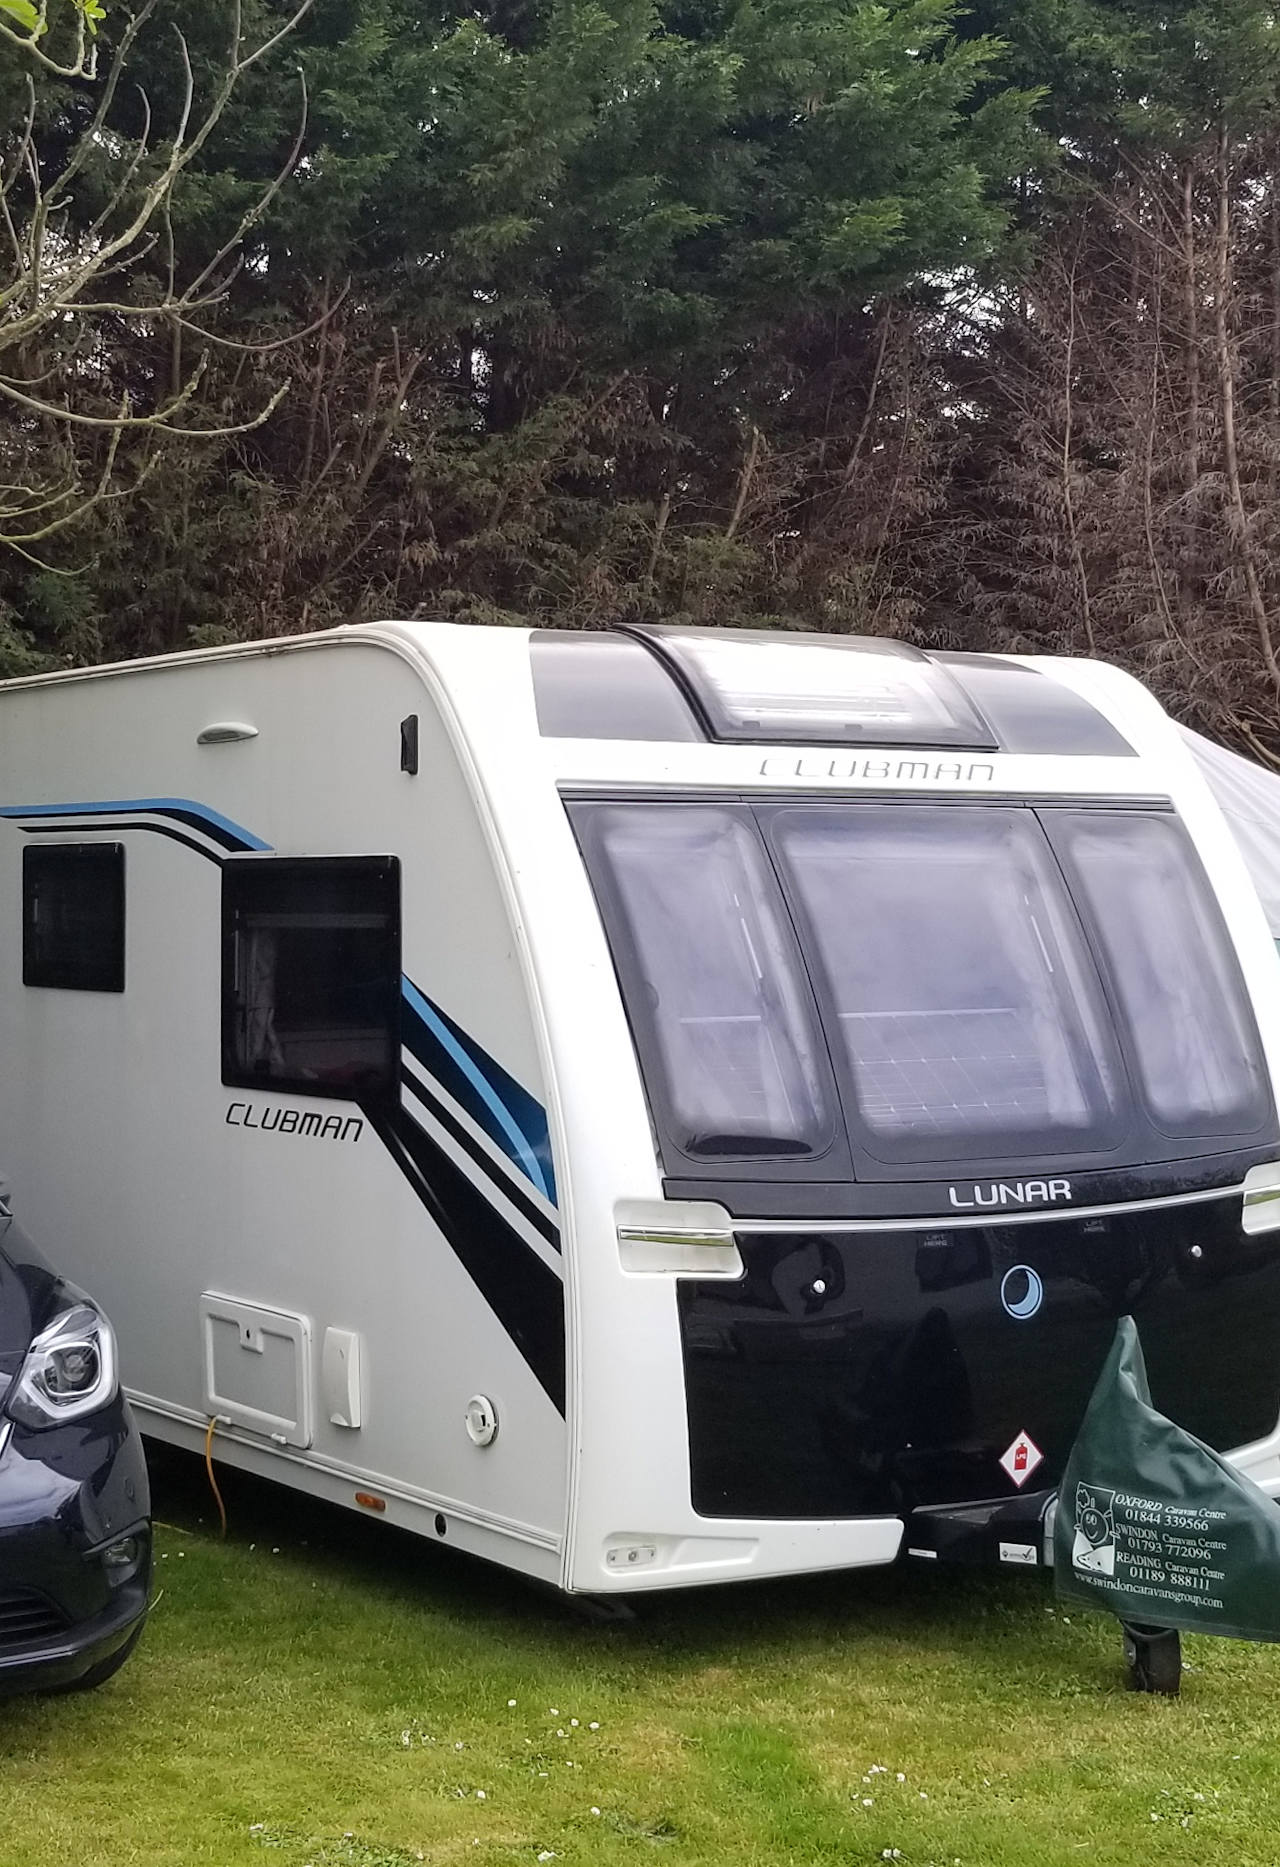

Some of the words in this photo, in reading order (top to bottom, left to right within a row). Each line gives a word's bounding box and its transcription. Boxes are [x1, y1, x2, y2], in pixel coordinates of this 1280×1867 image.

[759, 758, 994, 781] CLUBMAN
[225, 1102, 364, 1142] CLUBMAN
[948, 1179, 1072, 1207] LUNAR
[1114, 1493, 1163, 1511] OXFORD
[1164, 1505, 1198, 1517] Caravan
[1198, 1507, 1227, 1520] Centre
[1125, 1508, 1161, 1525] 01844
[1164, 1515, 1209, 1531] 339566
[1115, 1522, 1159, 1541] SWINDON
[1162, 1533, 1197, 1547] Caravan
[1197, 1538, 1227, 1550] Centre
[1127, 1537, 1163, 1553] 01793
[1164, 1544, 1212, 1560] 772096
[1116, 1551, 1162, 1569] READING
[1165, 1561, 1199, 1575] Caravan
[1200, 1566, 1226, 1580] Centre
[1129, 1566, 1166, 1582] 01189
[1170, 1573, 1210, 1591] 888111
[1074, 1571, 1224, 1609] www.swindoncaravansgroup.com
